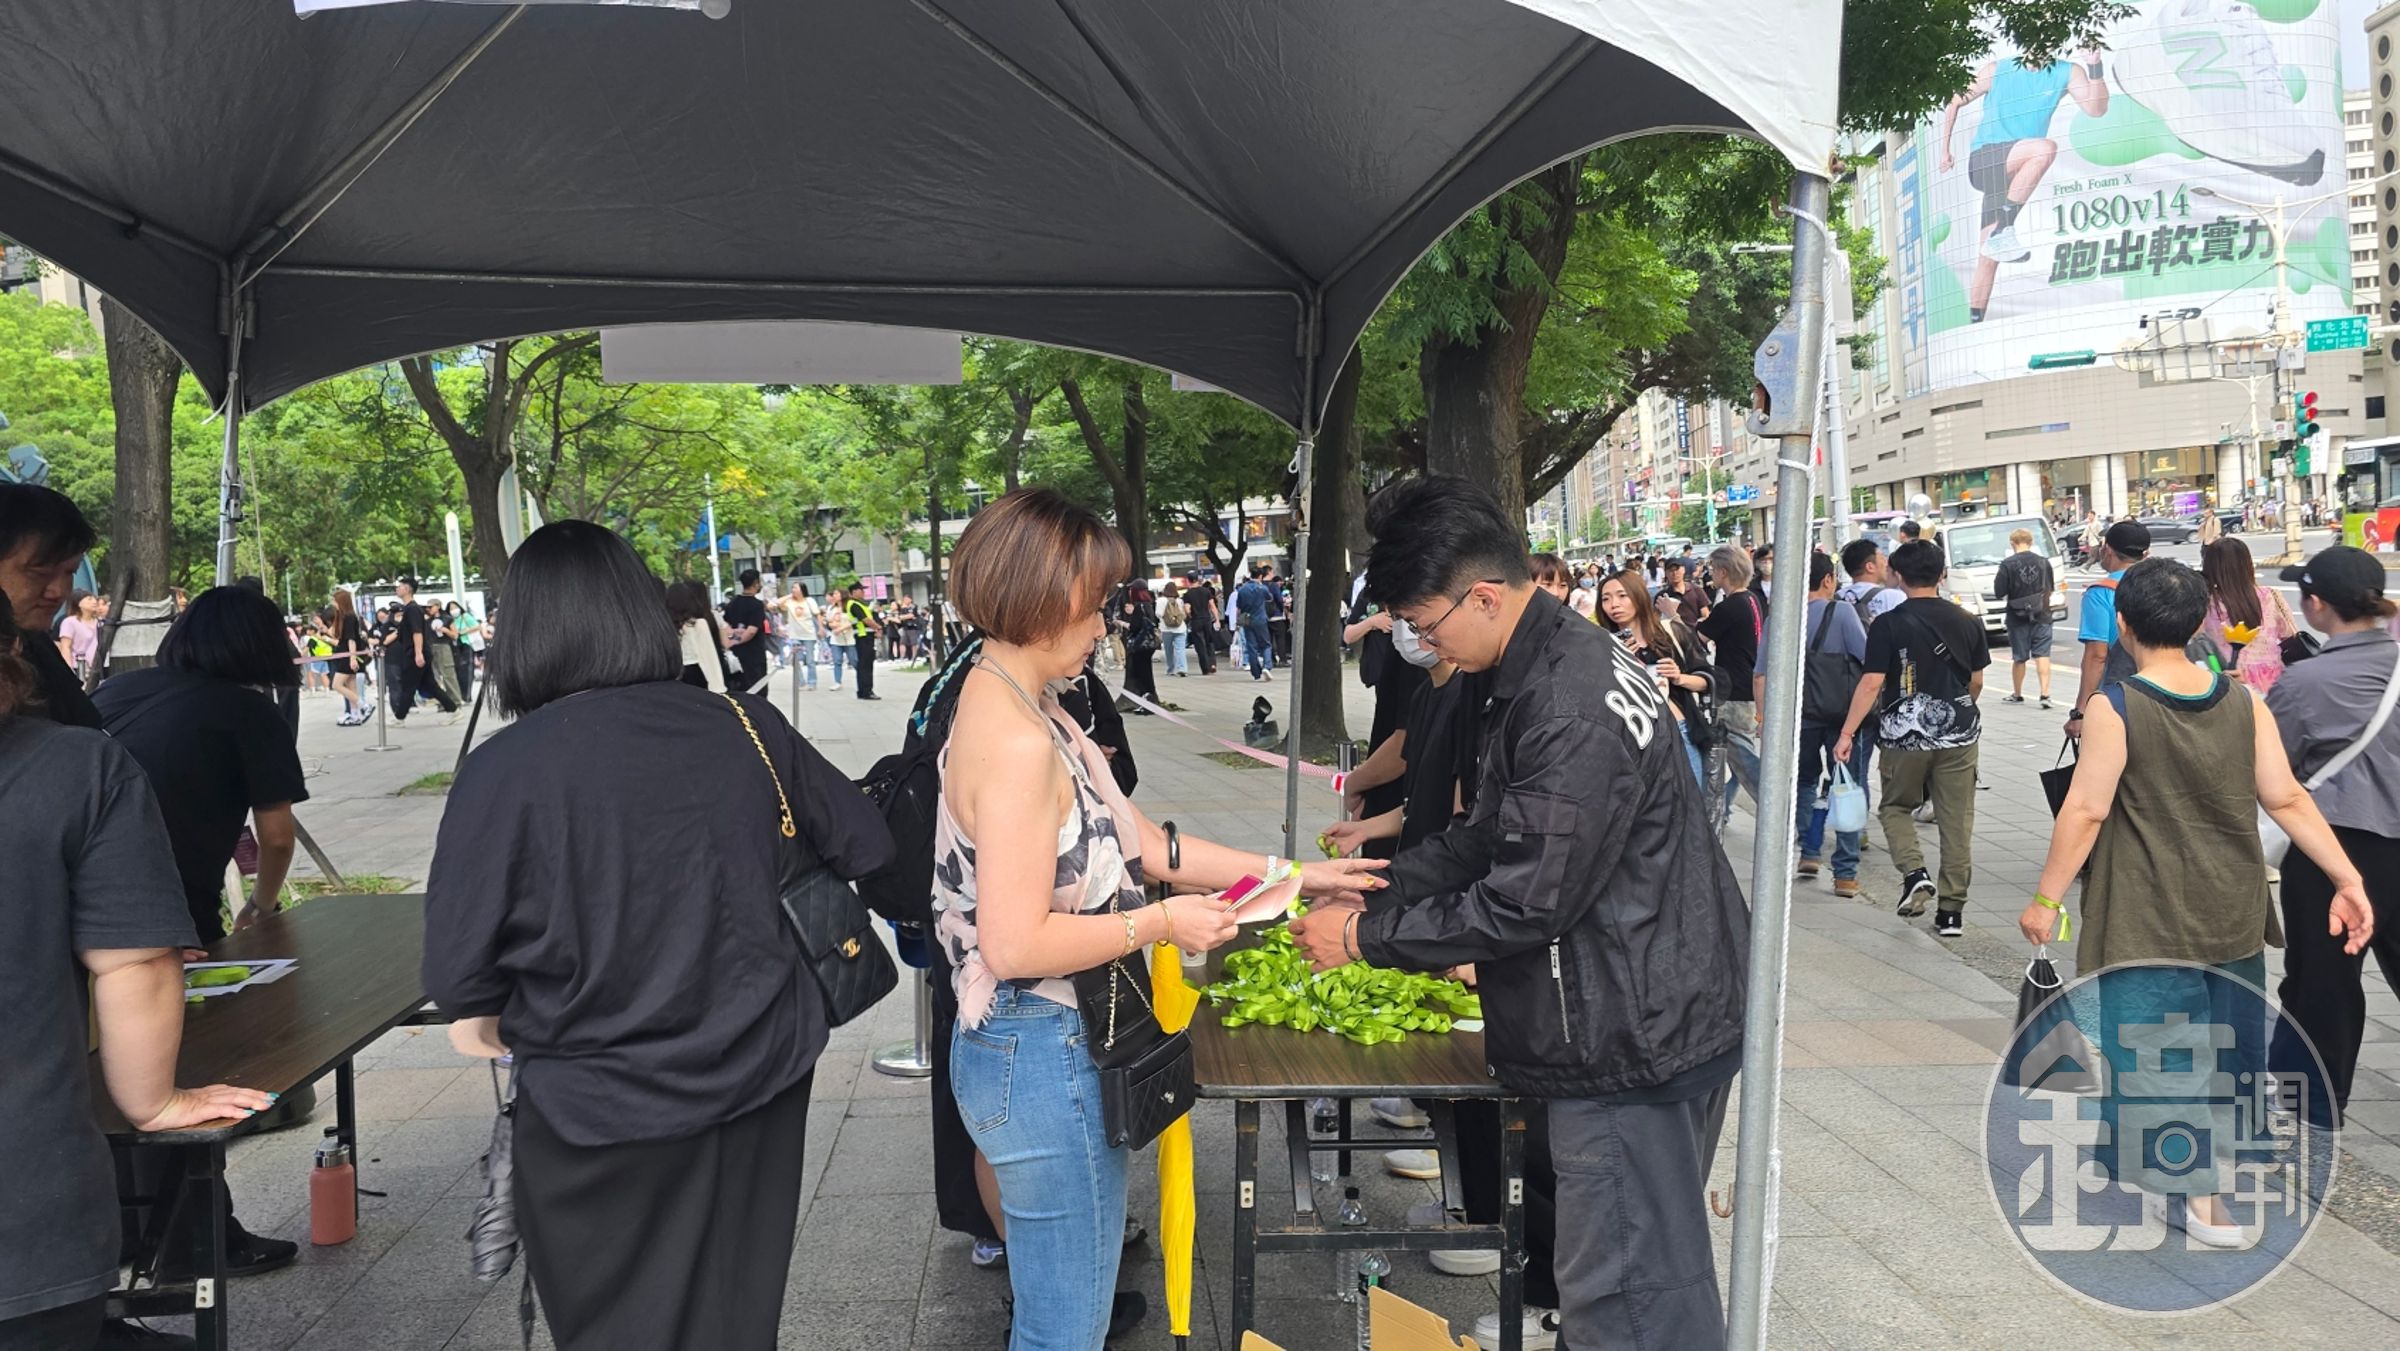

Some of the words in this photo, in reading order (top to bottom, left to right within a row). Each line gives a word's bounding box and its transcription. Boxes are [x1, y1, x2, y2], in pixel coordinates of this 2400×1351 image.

[2052, 183, 2191, 235] 1080v14
[2053, 183, 2083, 196] Fresh
[2088, 176, 2119, 190] Foam
[2124, 173, 2133, 184] X
[2048, 216, 2276, 284] 跑出軟實力
